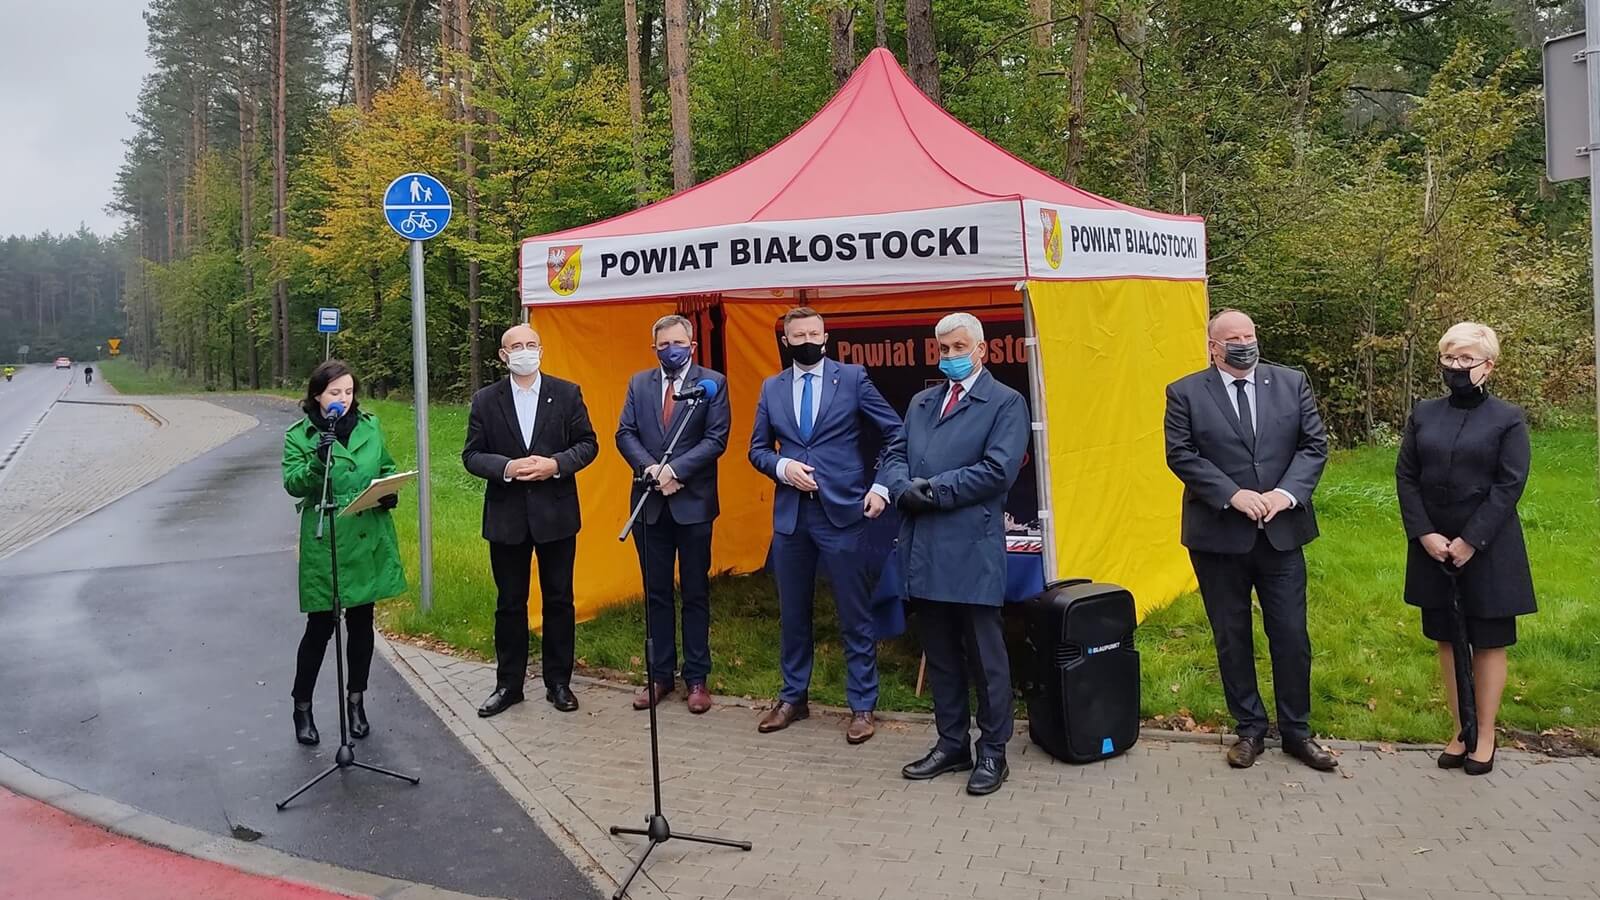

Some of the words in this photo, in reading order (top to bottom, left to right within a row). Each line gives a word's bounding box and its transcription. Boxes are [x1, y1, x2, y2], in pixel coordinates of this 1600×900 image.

[601, 242, 719, 278] POWIAT
[730, 225, 979, 265] BIAŁOSTOCKI
[1070, 225, 1121, 252] POWIAT
[1125, 228, 1198, 258] BIAŁOSTOCKI
[837, 338, 916, 367] Powiat
